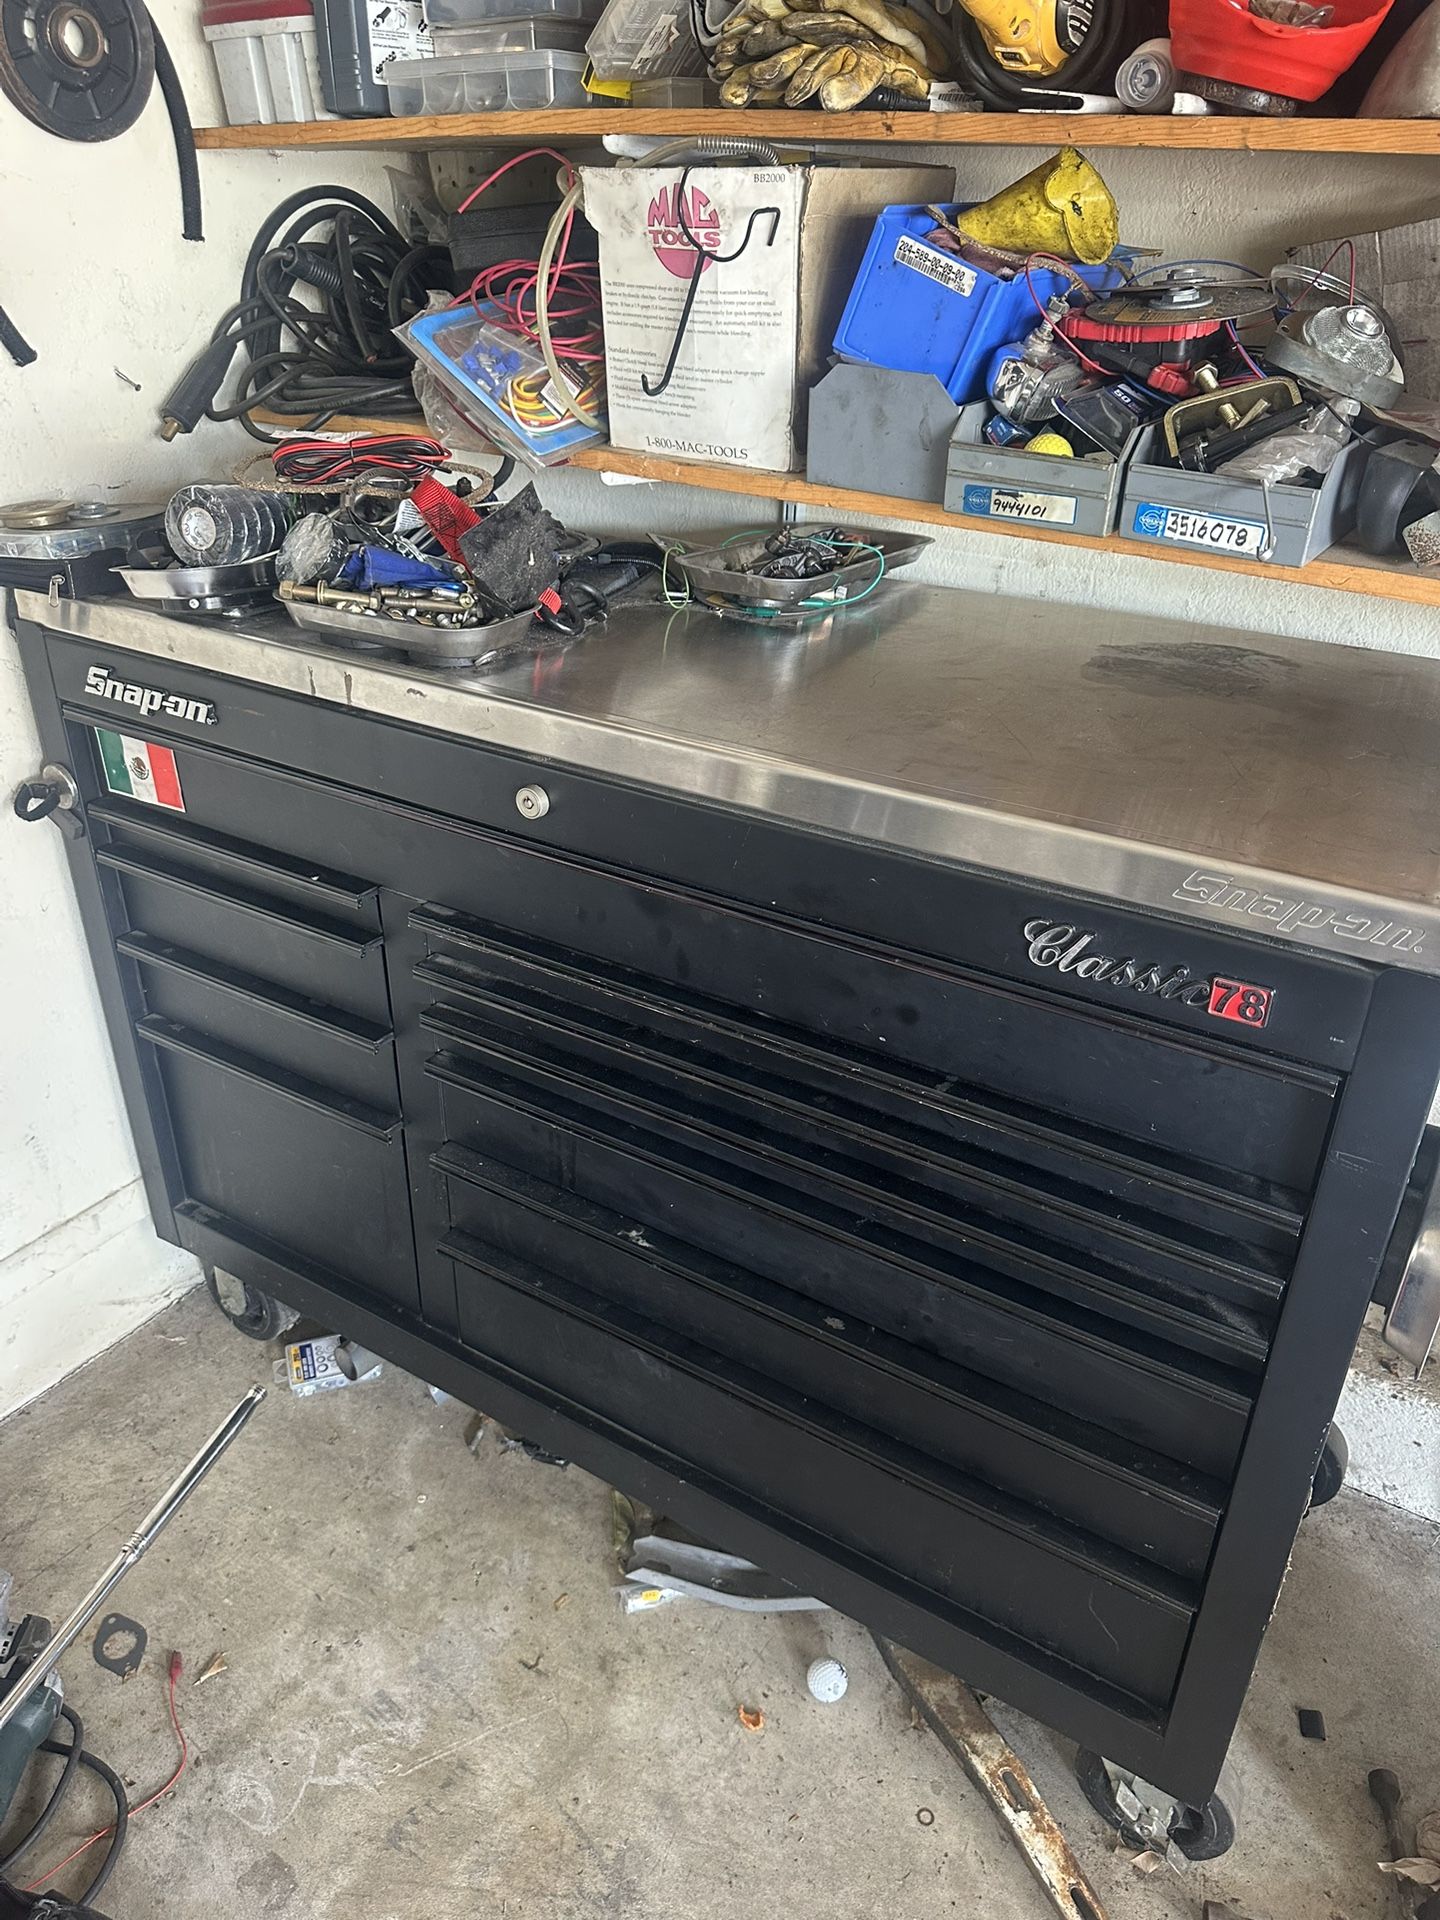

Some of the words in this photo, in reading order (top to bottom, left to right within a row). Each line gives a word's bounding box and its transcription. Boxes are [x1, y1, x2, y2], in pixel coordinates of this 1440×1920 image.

[753, 172, 786, 183] BB2000
[648, 182, 721, 229] MAC
[1113, 388, 1132, 404] 50
[645, 435, 749, 460] 1-800-MAC-TOOLS
[993, 498, 1047, 518] 9444101
[1167, 512, 1248, 546] 3516078
[84, 665, 217, 725] Snap-on
[1172, 869, 1427, 954] Snap-on
[1023, 917, 1211, 1007] Classic
[1214, 980, 1266, 1022] 78
